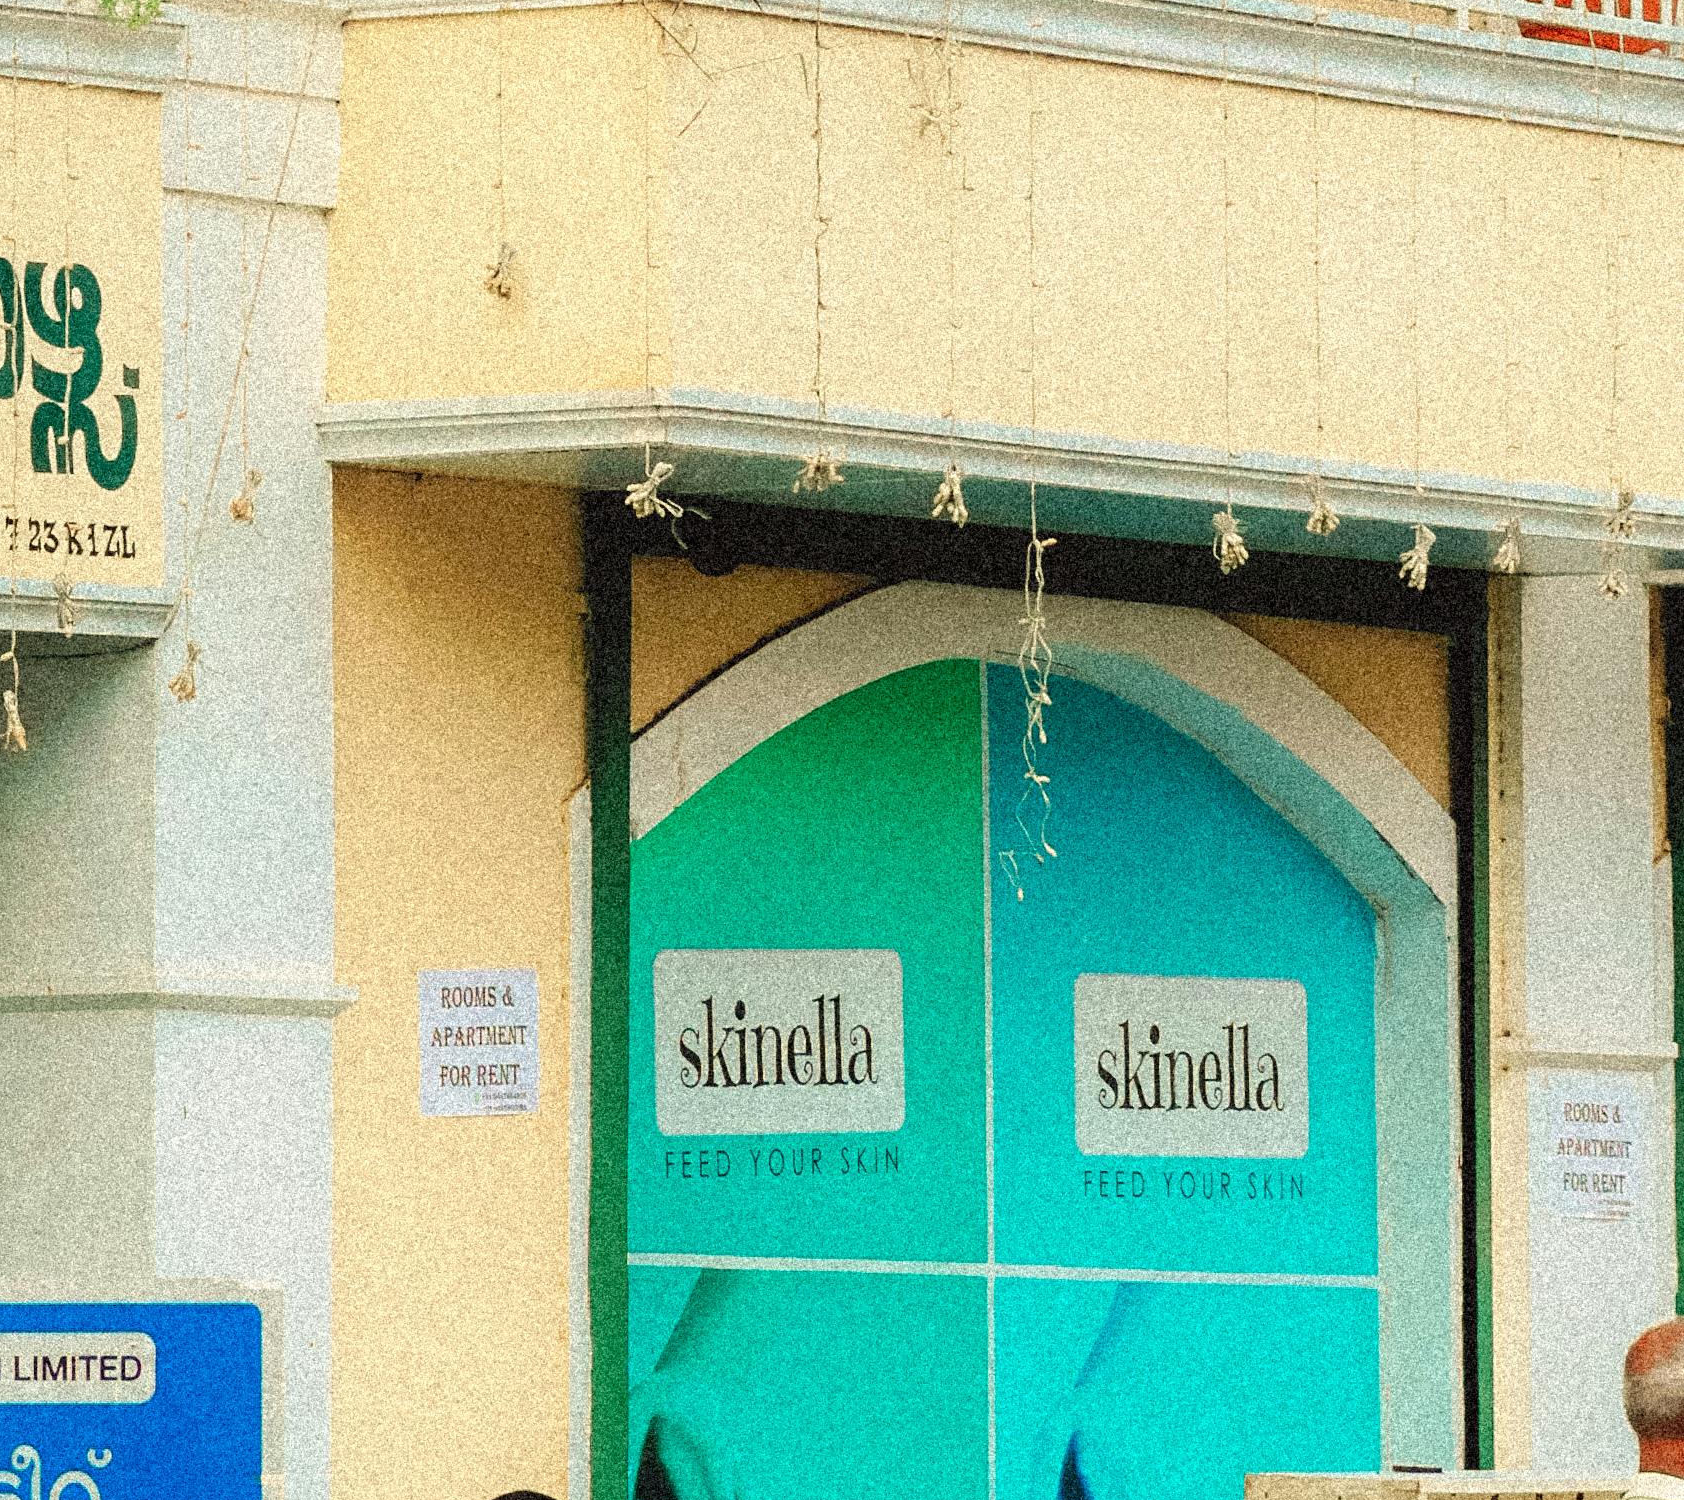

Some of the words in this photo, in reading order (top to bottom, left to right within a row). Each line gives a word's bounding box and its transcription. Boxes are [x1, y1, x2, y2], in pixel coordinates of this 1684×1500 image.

[440, 985, 497, 1010] ROOMS
[501, 985, 515, 1008] &
[430, 1024, 528, 1048] APARTMENT
[679, 994, 879, 1090] skinella
[439, 1064, 472, 1087] FOR
[476, 1063, 521, 1087] RENT
[1097, 1019, 1285, 1114] skinella
[1563, 1102, 1609, 1124] ROOMS
[1612, 1104, 1622, 1124] &
[1556, 1137, 1633, 1158] APARTMENT
[665, 1146, 732, 1180] FEED
[748, 1147, 823, 1178] YOUR
[840, 1144, 902, 1176] SKIN
[1083, 1169, 1147, 1199] FEED
[1164, 1169, 1232, 1199] YOUR
[1247, 1170, 1306, 1200] SKIN
[1562, 1172, 1589, 1193] FOR
[1591, 1174, 1626, 1195] RENT
[13, 1355, 143, 1382] LIMITED
